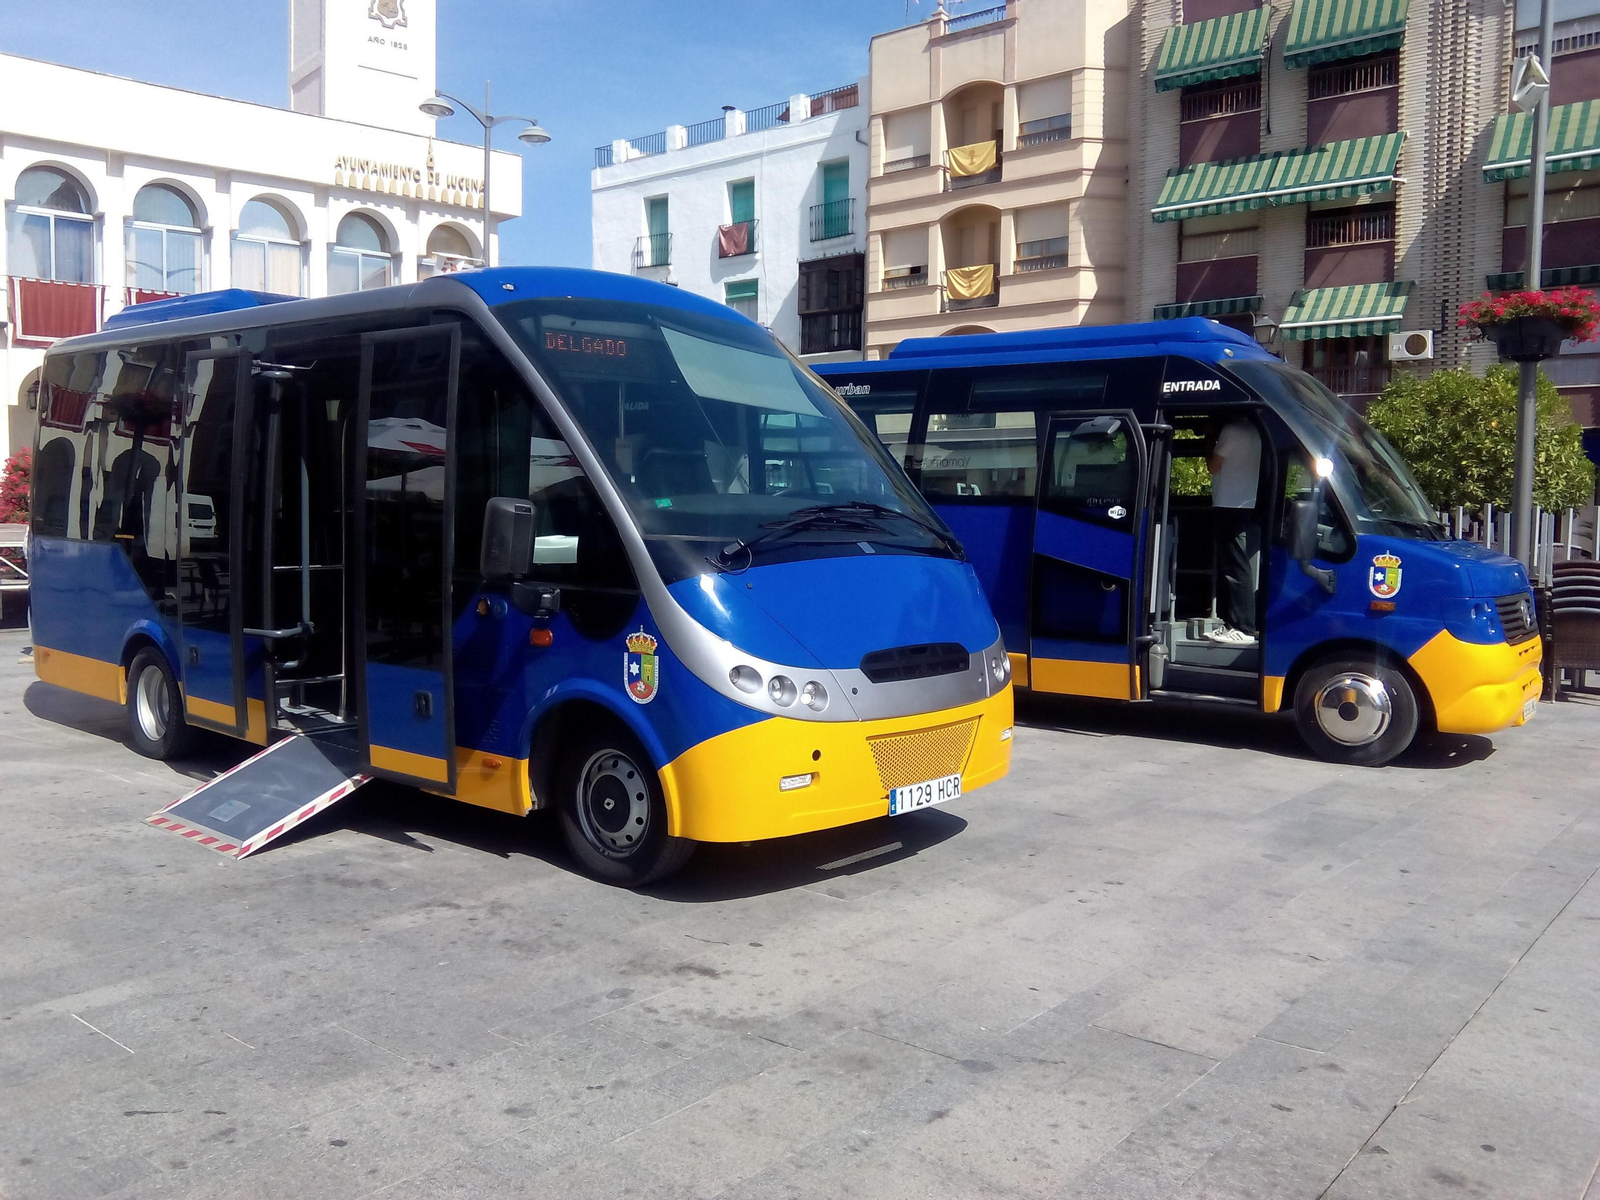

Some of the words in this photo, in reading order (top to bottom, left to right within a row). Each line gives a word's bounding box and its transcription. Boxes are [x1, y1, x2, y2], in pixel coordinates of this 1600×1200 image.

[335, 155, 421, 183] AYUNTAMIENTO
[427, 170, 440, 186] DE
[545, 332, 626, 356] DELGADO
[1163, 380, 1221, 393] ENTRADA
[621, 401, 649, 410] ALIDA
[900, 784, 932, 810] 1129
[938, 776, 960, 801] HCR
